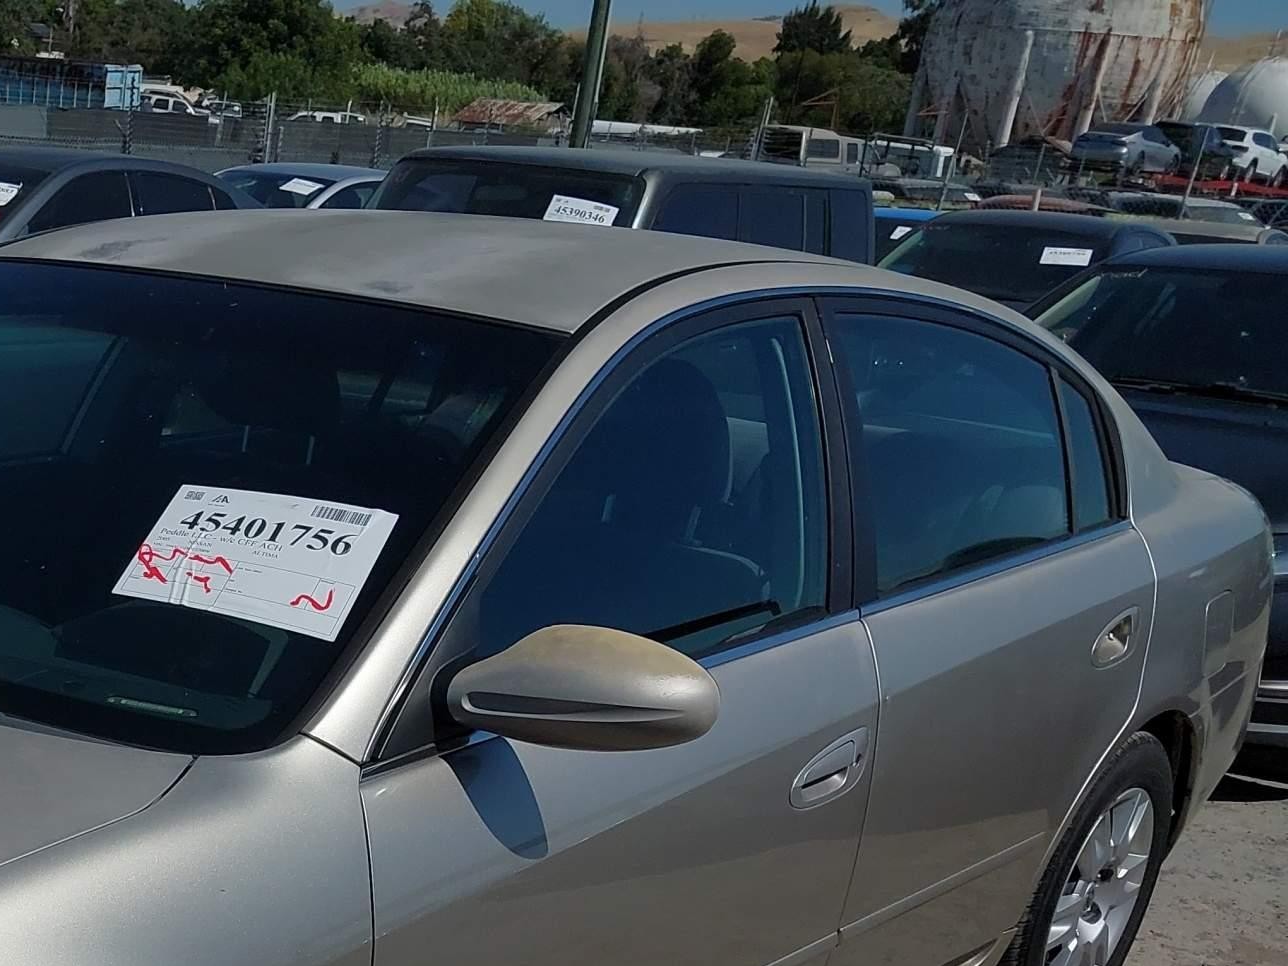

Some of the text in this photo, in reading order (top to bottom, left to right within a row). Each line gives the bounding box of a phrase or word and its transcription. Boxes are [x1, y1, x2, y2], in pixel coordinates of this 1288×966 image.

[554, 206, 606, 223] 45390346
[160, 528, 189, 537] Peddle
[180, 511, 359, 556] 45401756
